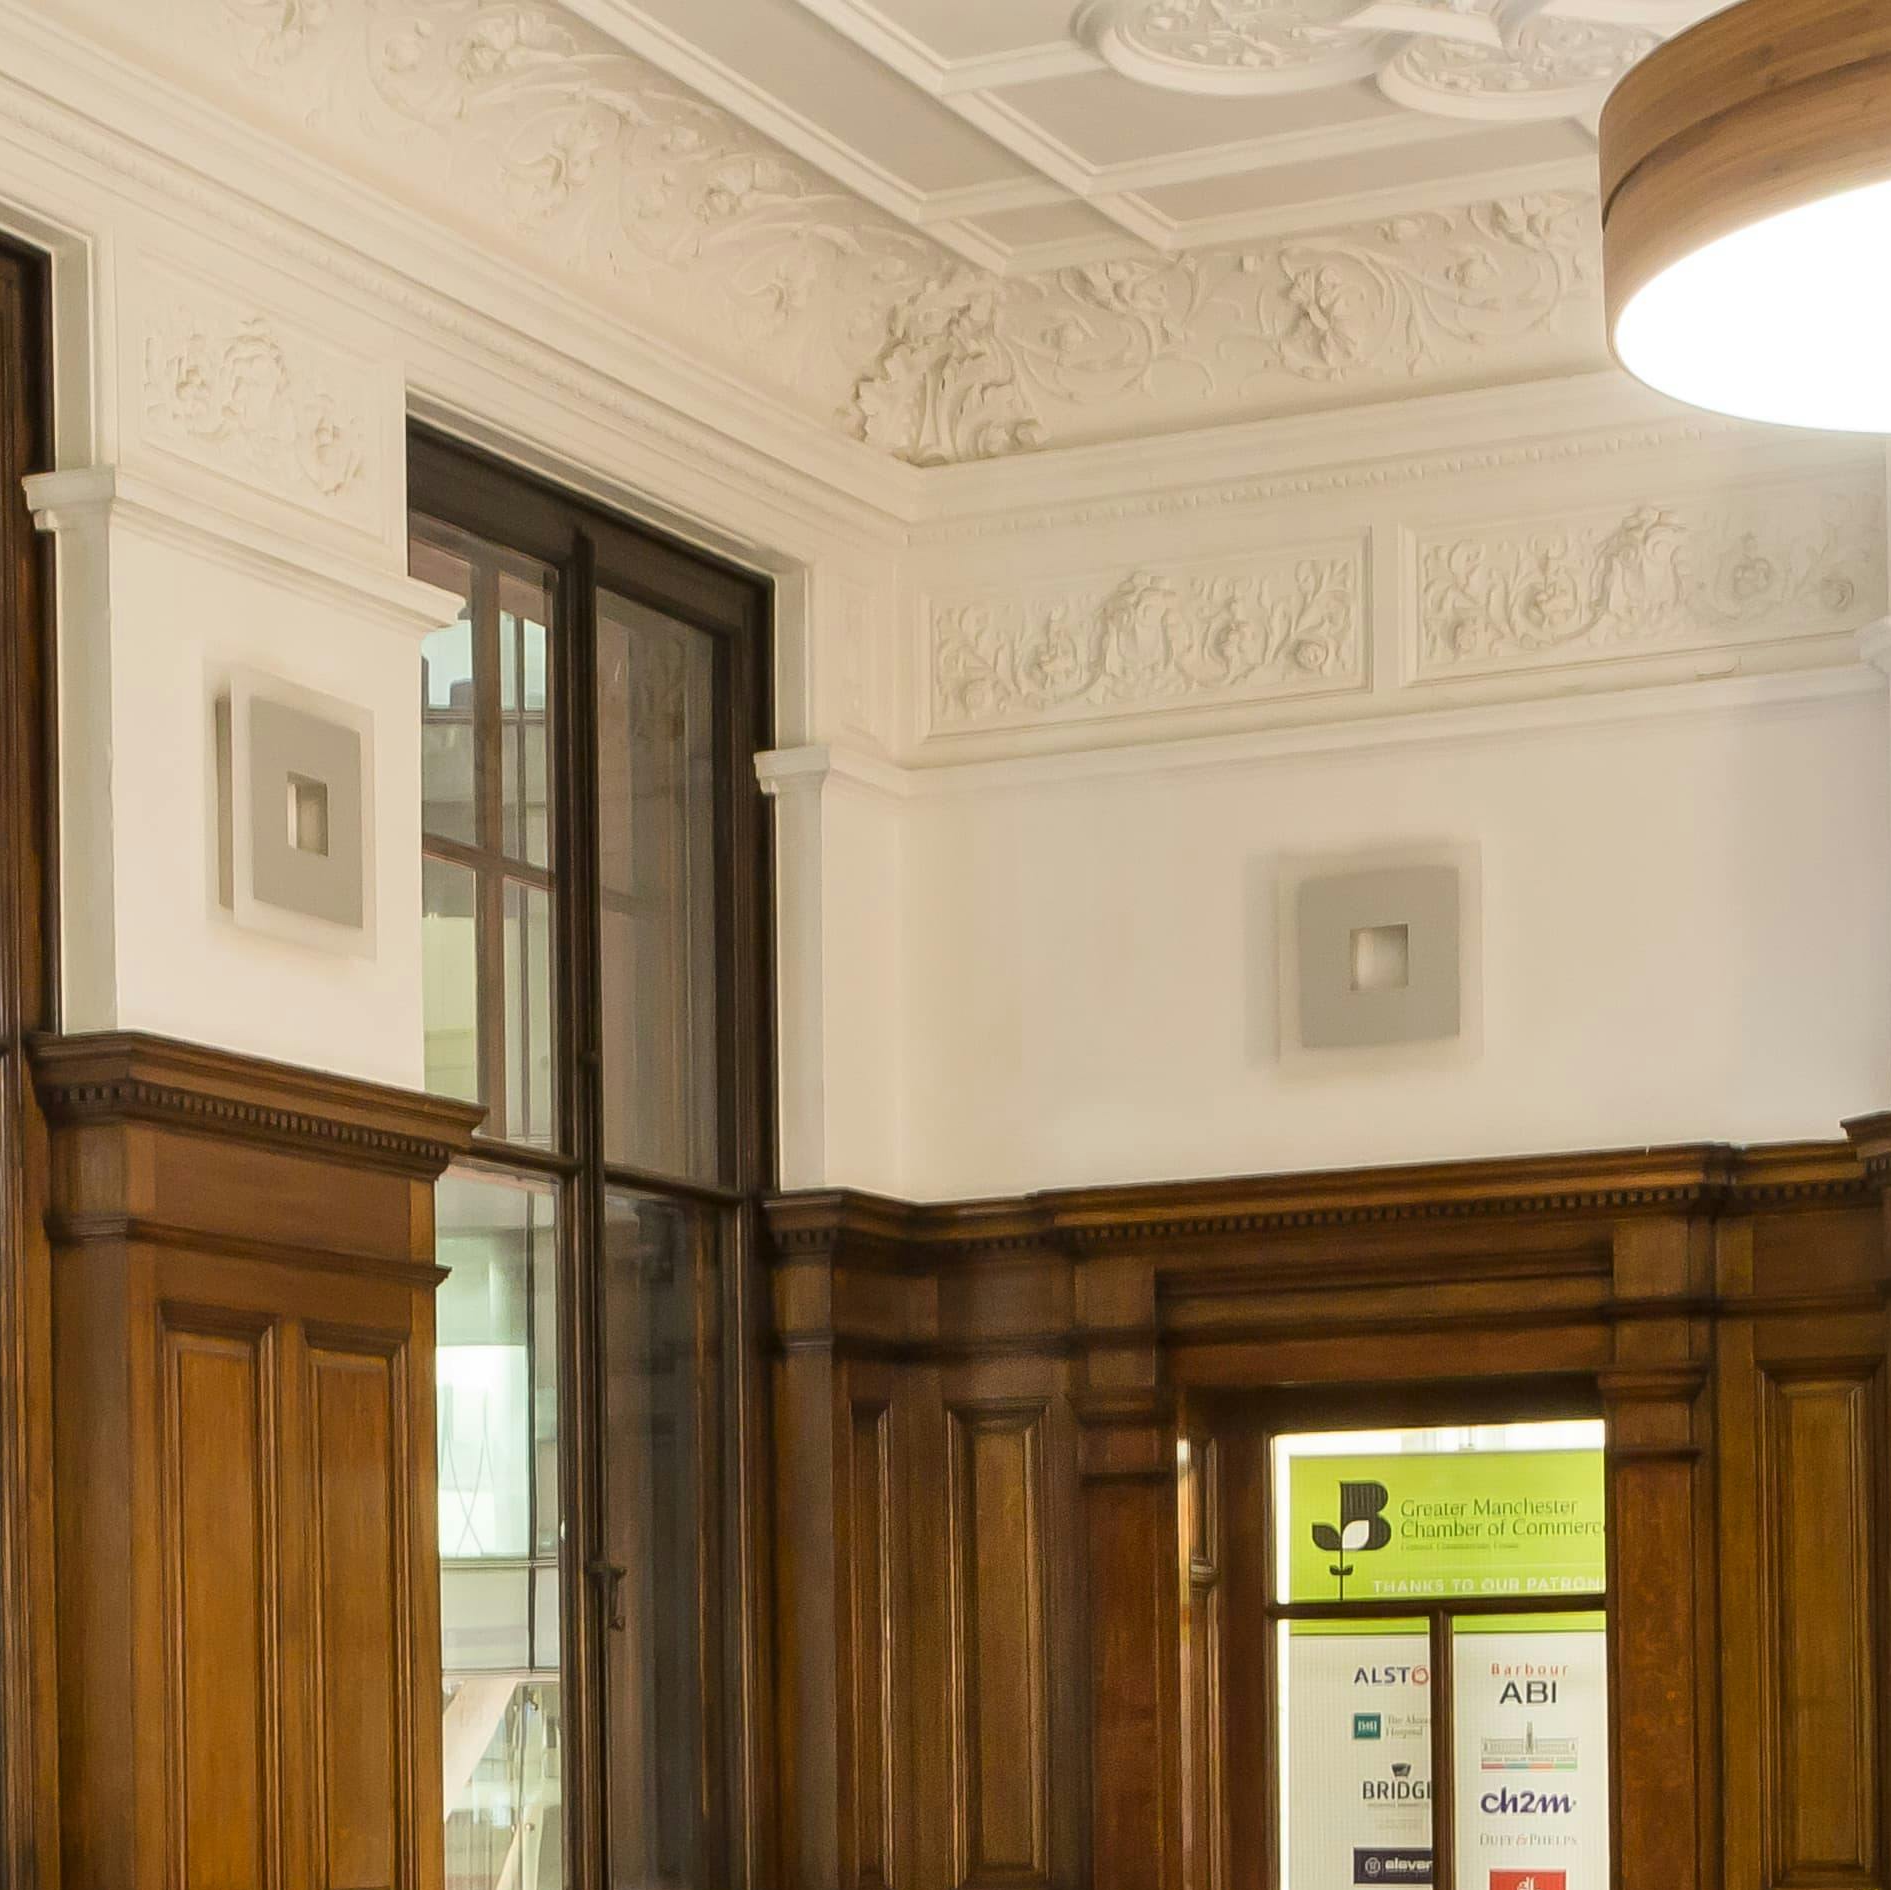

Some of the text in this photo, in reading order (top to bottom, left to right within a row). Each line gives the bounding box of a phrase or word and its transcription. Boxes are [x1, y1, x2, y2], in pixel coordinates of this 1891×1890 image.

[1400, 1498, 1578, 1518] Greater Manchester
[1400, 1517, 1605, 1539] Chamber of Commerc
[1373, 1579, 1445, 1594] THANKS
[1453, 1578, 1474, 1593] TO
[1480, 1577, 1520, 1593] OUR
[1491, 1662, 1569, 1677] Barbour
[1499, 1680, 1557, 1705] ABI
